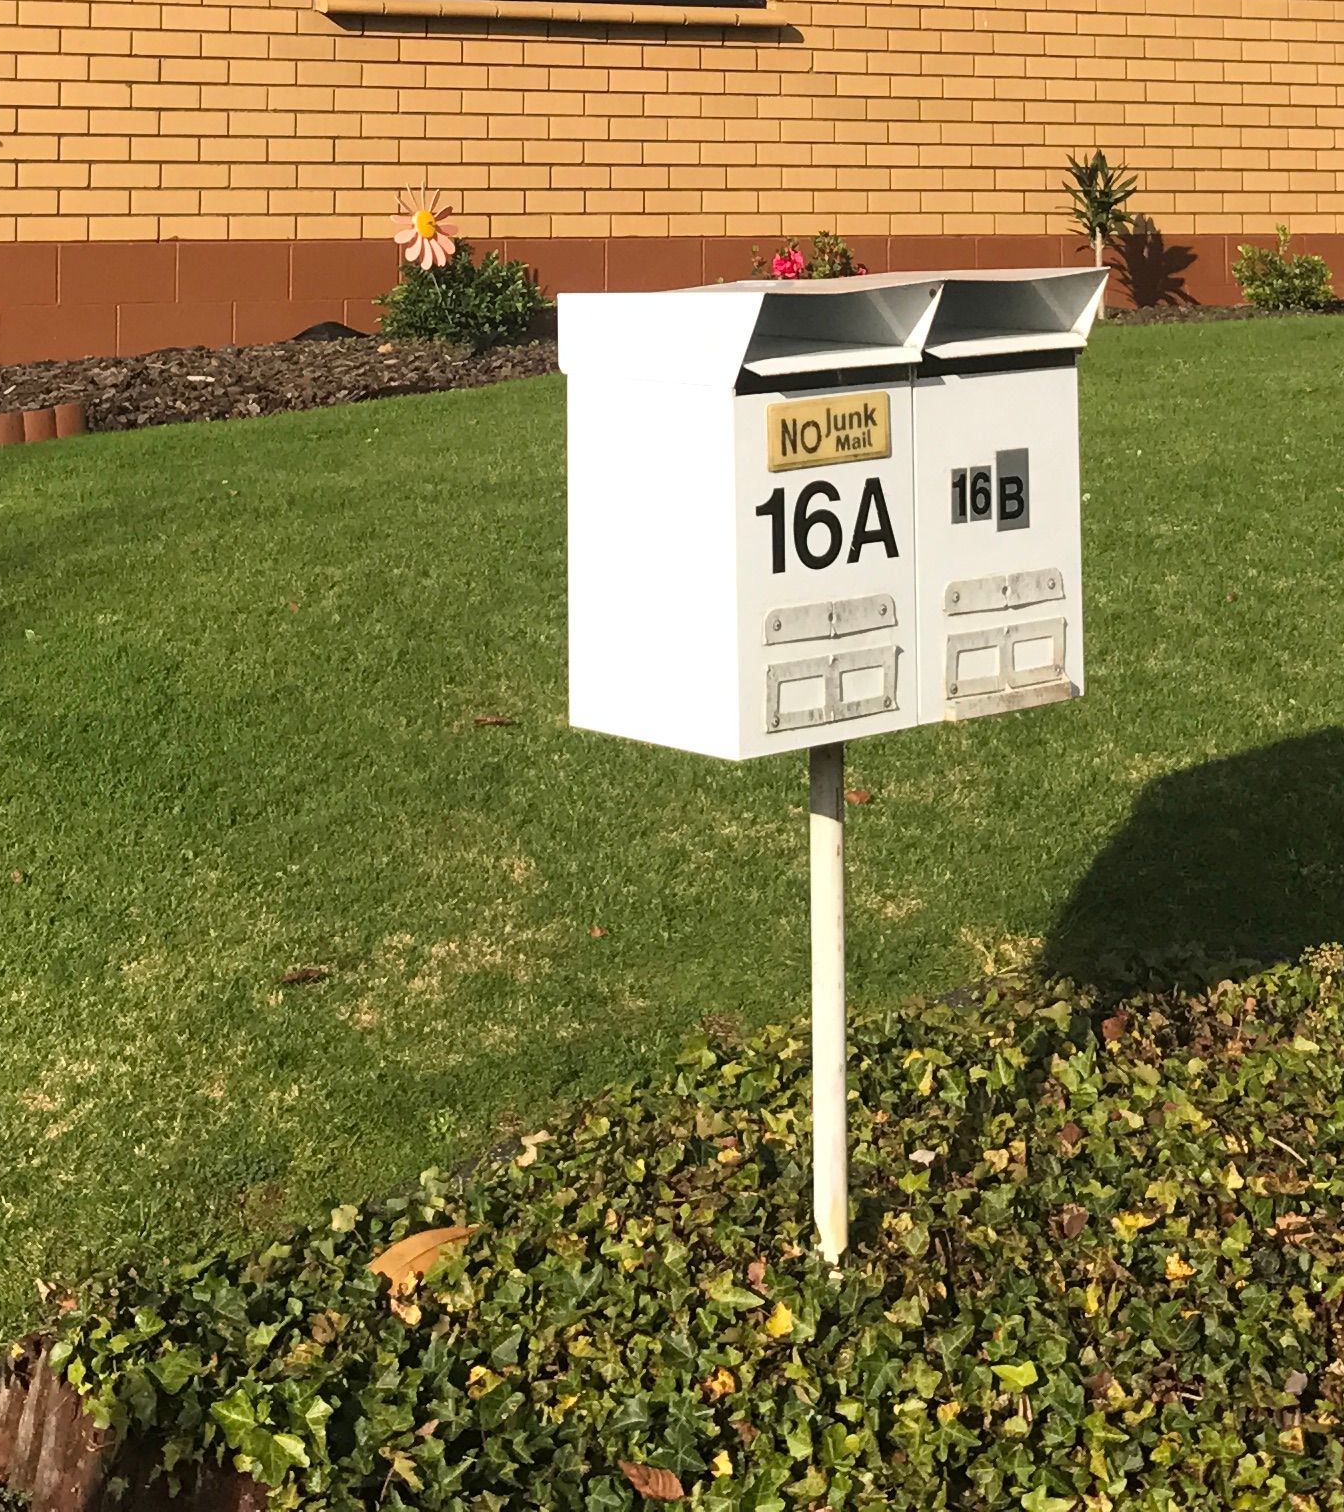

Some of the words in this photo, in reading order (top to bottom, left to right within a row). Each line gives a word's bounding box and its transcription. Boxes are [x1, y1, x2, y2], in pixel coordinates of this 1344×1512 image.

[780, 417, 822, 457] NO
[824, 402, 878, 438] Junk
[835, 428, 873, 452] Mail
[951, 471, 1025, 521] 16B
[755, 476, 900, 575] 16A
